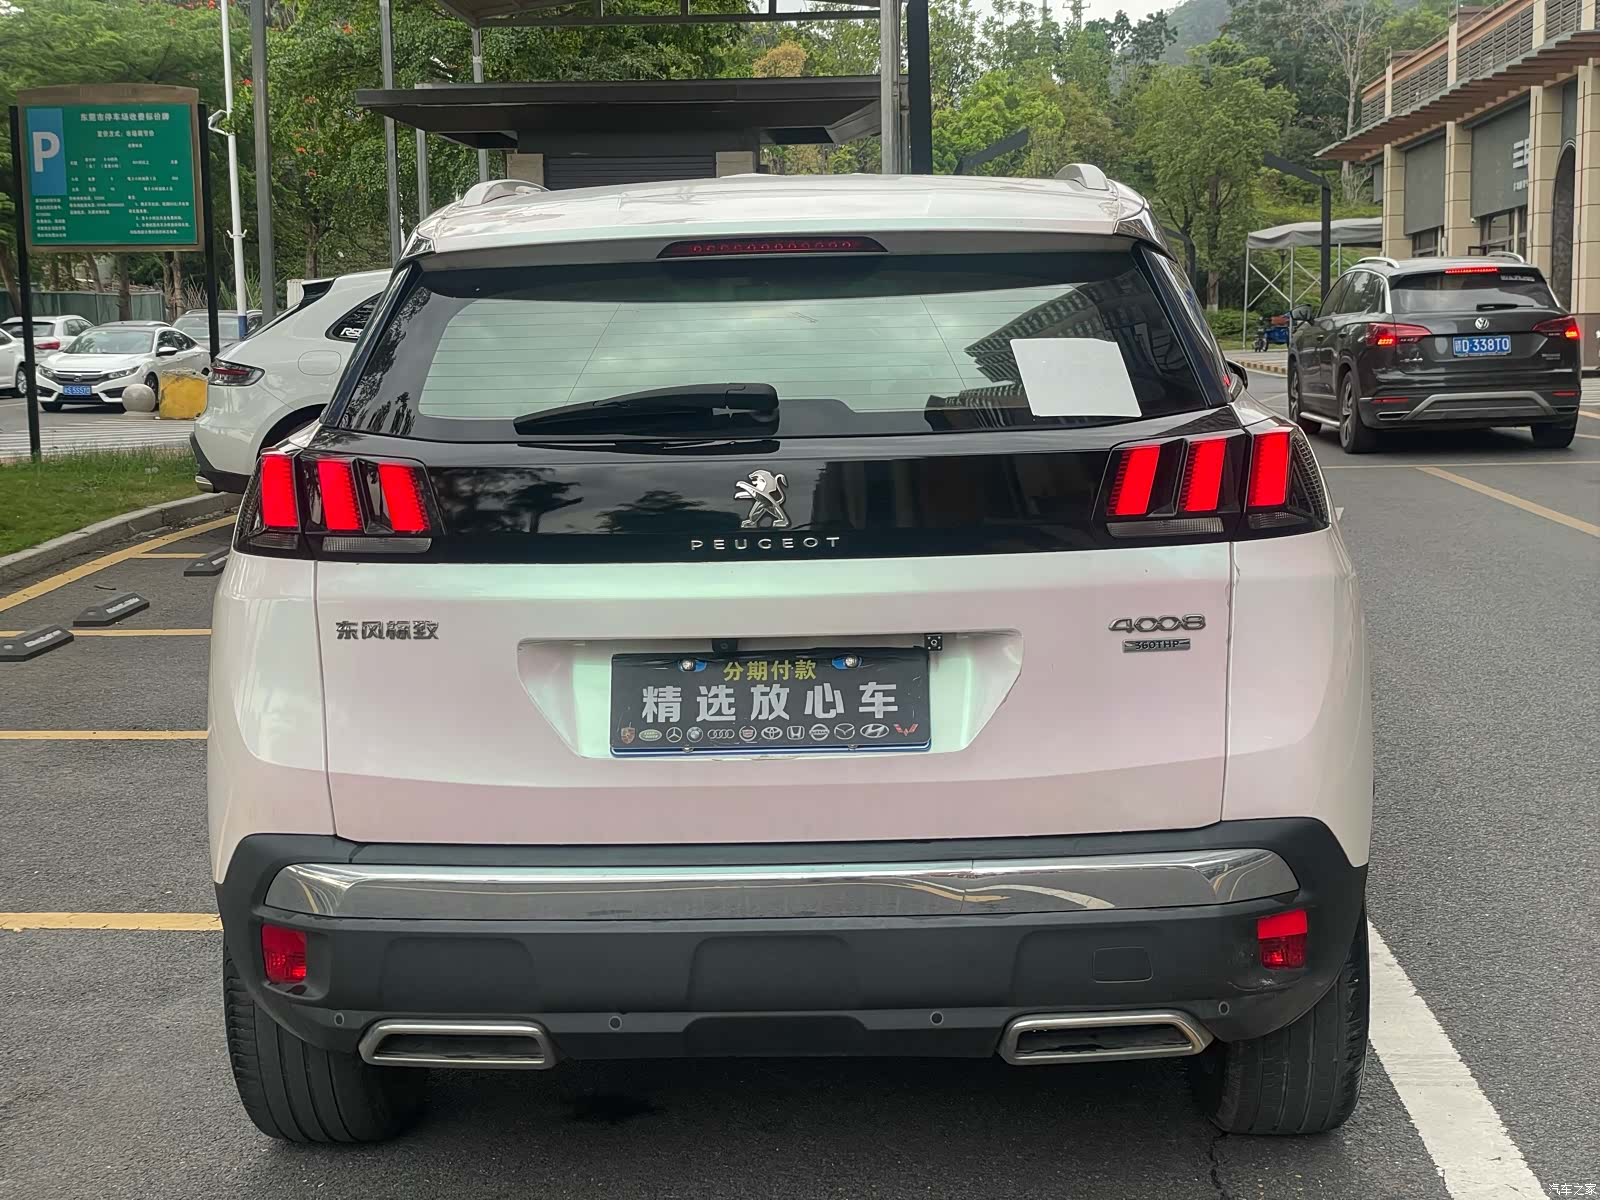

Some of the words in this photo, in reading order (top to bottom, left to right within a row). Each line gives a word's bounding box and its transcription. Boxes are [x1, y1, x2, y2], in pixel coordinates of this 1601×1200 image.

[32, 131, 60, 173] P
[690, 536, 841, 550] PEUGEOT
[336, 620, 439, 640] 东风标致
[1109, 614, 1206, 633] 4008
[1135, 640, 1180, 650] 360THP
[723, 660, 817, 681] 分期付款
[642, 682, 898, 723] 精选放心车
